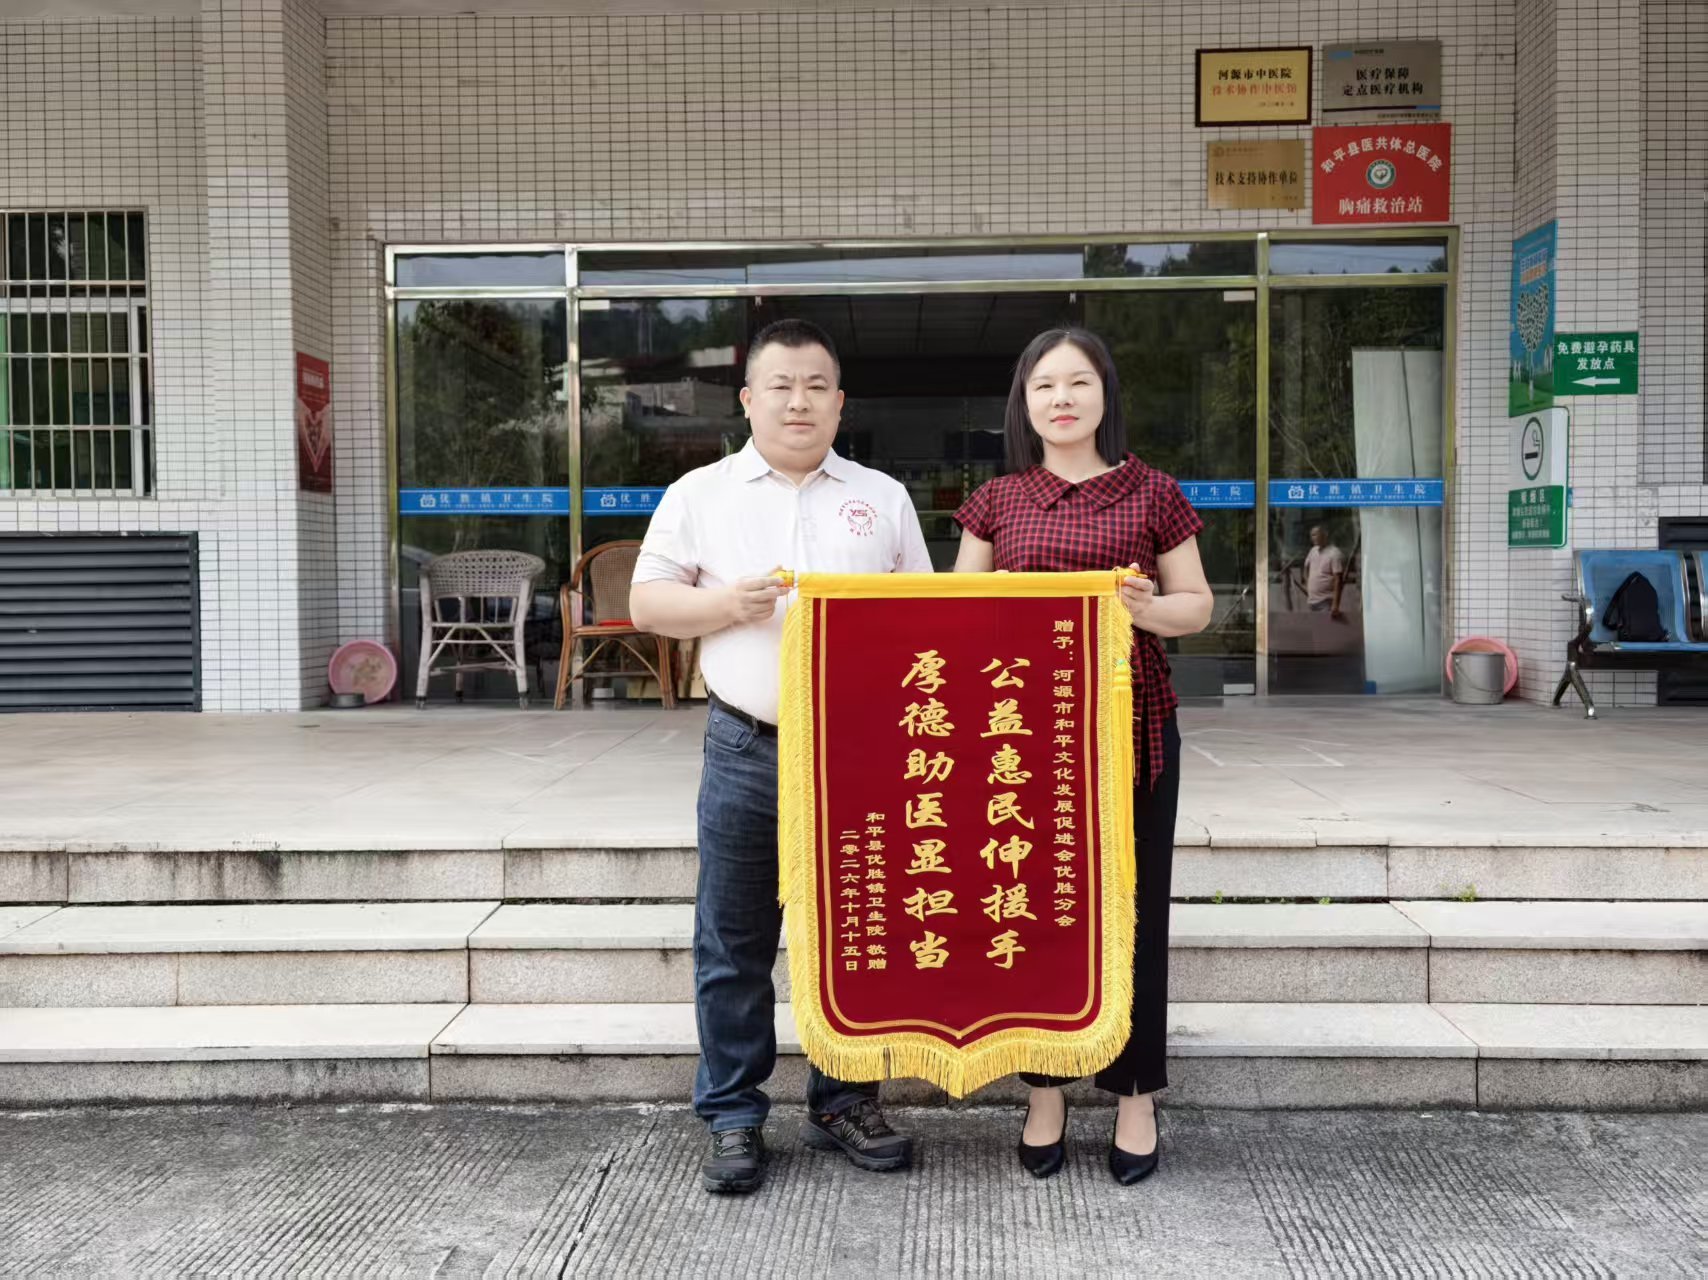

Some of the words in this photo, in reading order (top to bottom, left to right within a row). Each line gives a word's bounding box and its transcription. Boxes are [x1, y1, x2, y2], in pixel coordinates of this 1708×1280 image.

[1218, 67, 1292, 81] 河源市中医院
[1356, 67, 1410, 81] 医疗保障
[1343, 81, 1424, 96] 定点医疗机构
[1320, 136, 1443, 174] 和平县医共体总医院
[1215, 170, 1298, 186] 技术支持协作单位
[1338, 196, 1423, 216] 胸痛救治站
[1557, 340, 1635, 355] 免费避孕药具
[1576, 357, 1616, 371] 发放点
[898, 649, 959, 971] 厚德助医显担当
[979, 656, 1038, 971] 公益惠民伸援手
[840, 830, 861, 971] 二零二六年十月十五日
[866, 944, 887, 971] 敬赠
